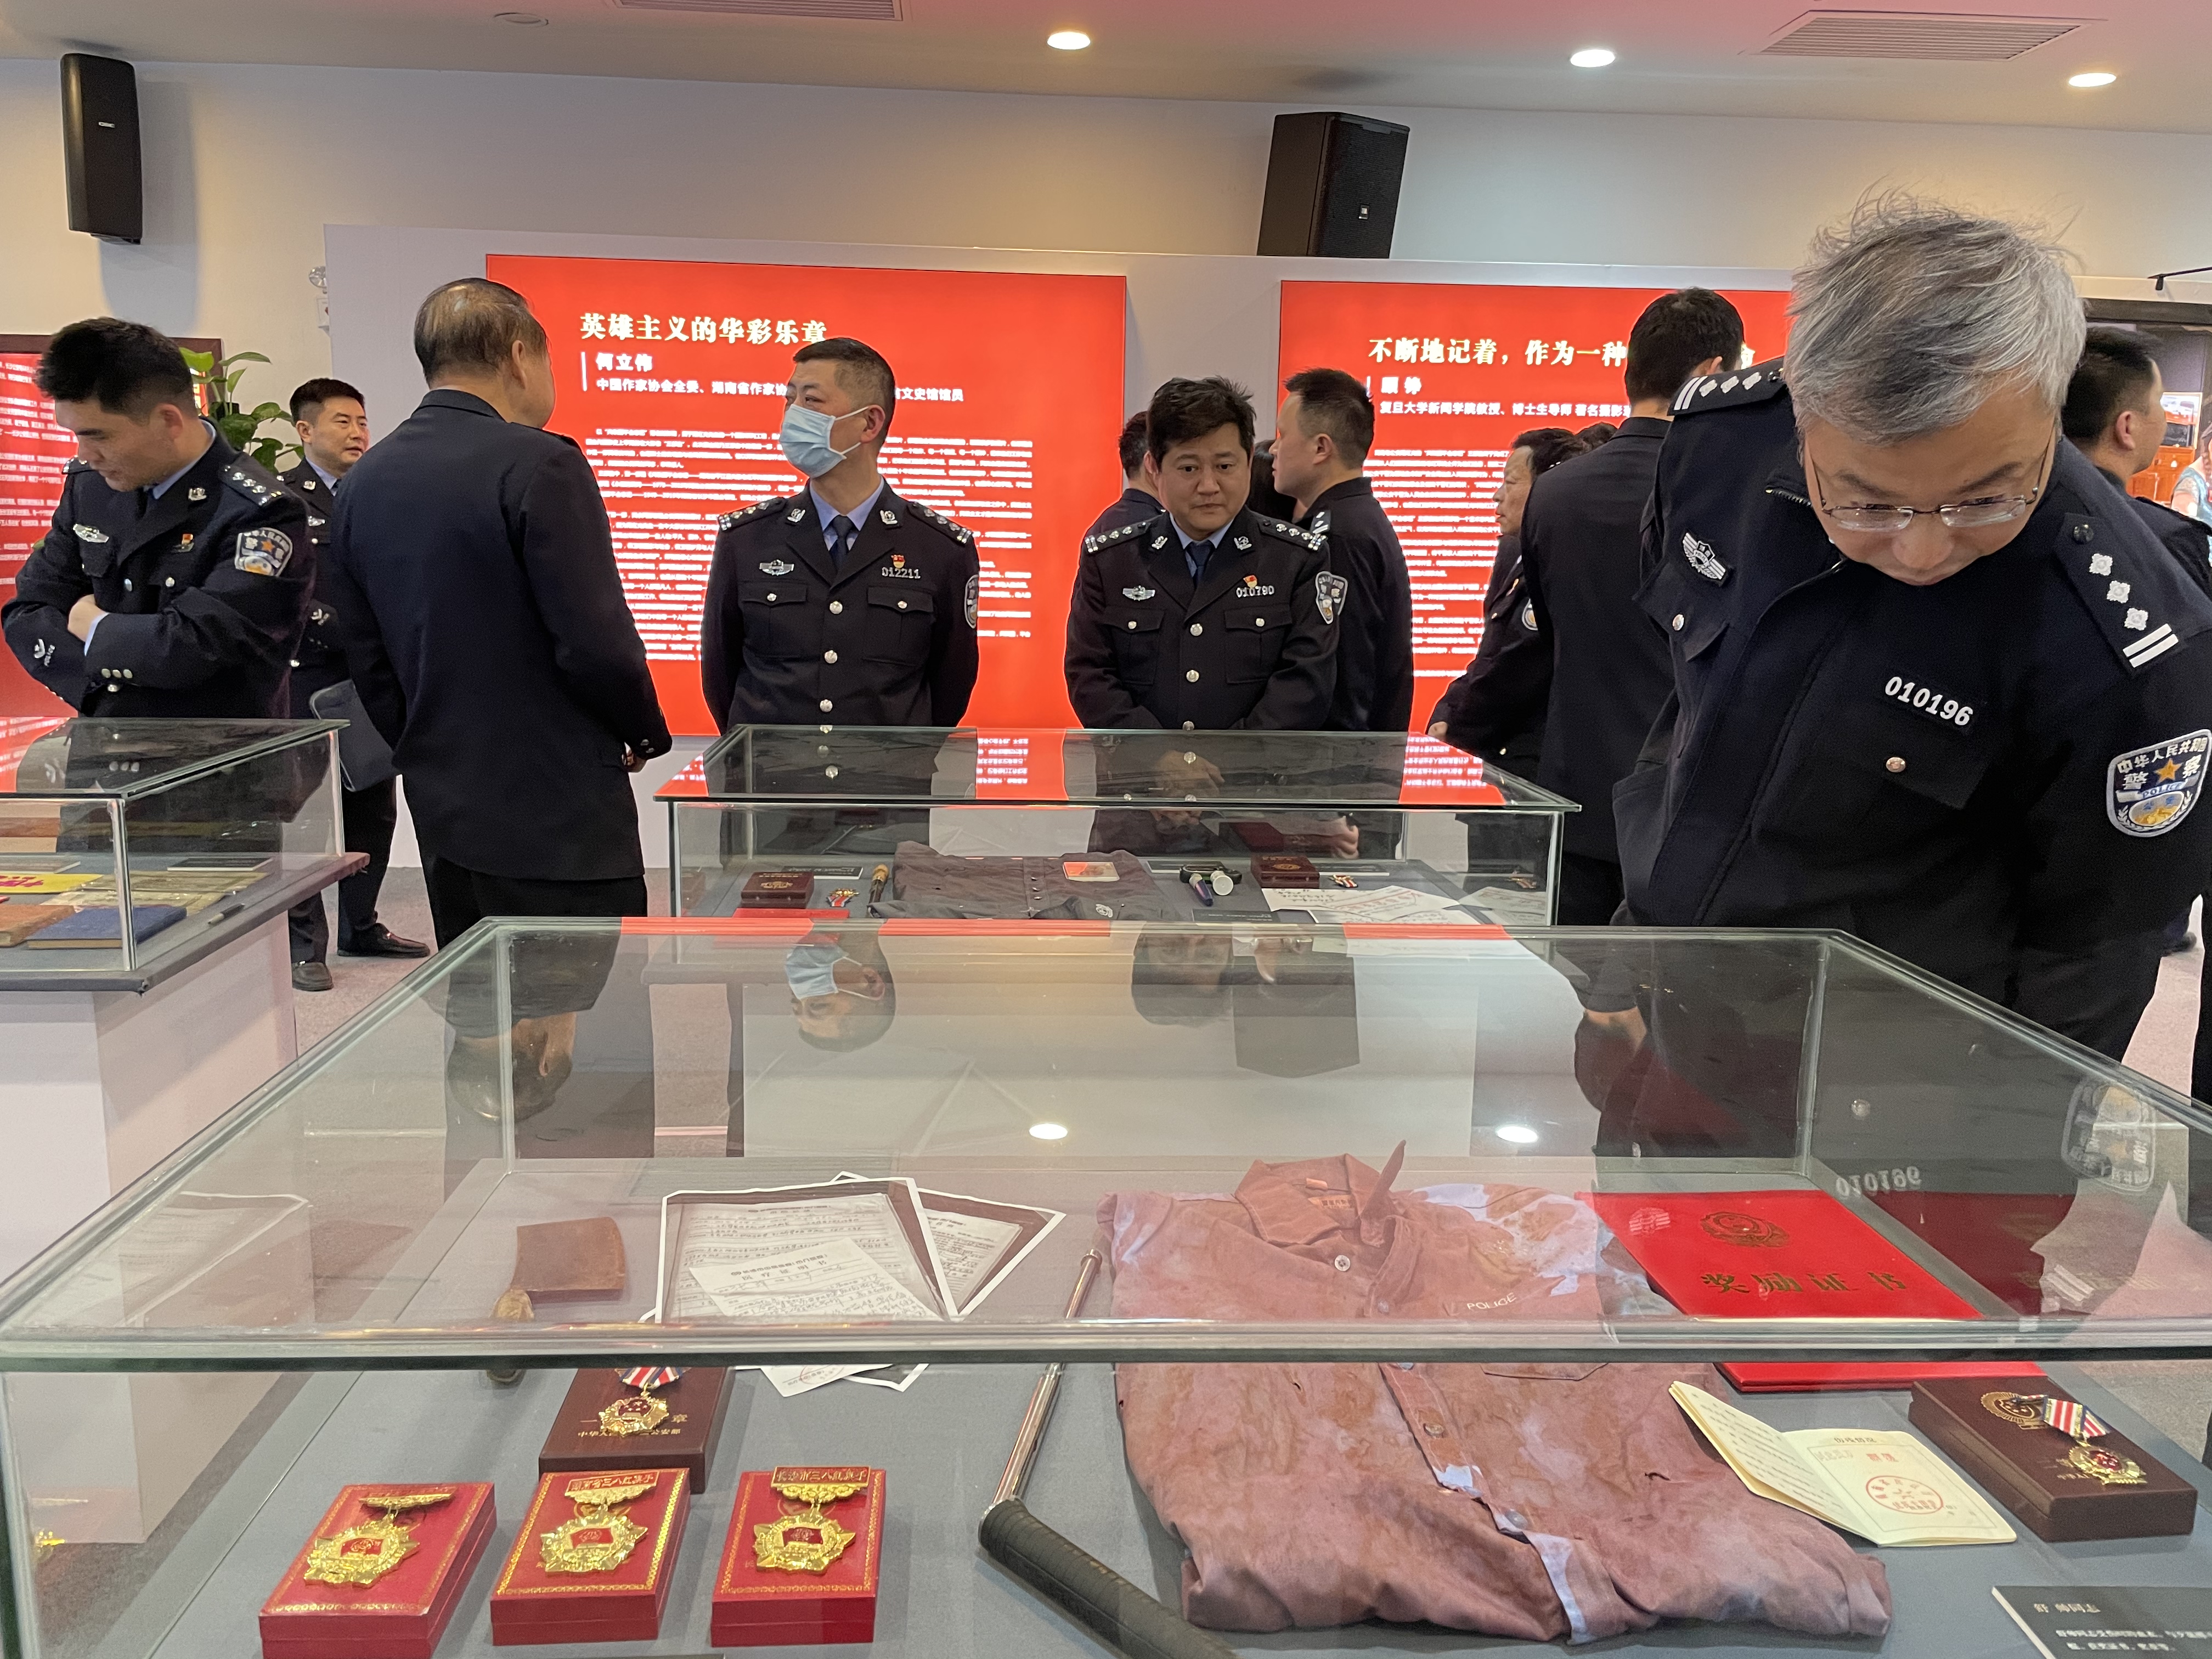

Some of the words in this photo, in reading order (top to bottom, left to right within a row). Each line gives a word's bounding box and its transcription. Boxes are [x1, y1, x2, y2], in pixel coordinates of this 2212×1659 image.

[580, 313, 827, 345] 英雄主义的华彩乐章
[1368, 337, 1627, 367] 不断地记着，作为一种
[595, 352, 653, 372] 何立伟
[882, 567, 921, 579] 012211
[1236, 585, 1275, 597] 010790
[1884, 676, 1973, 726] 010196
[2142, 781, 2183, 799] POLICE
[1466, 1292, 1517, 1310] POLICE
